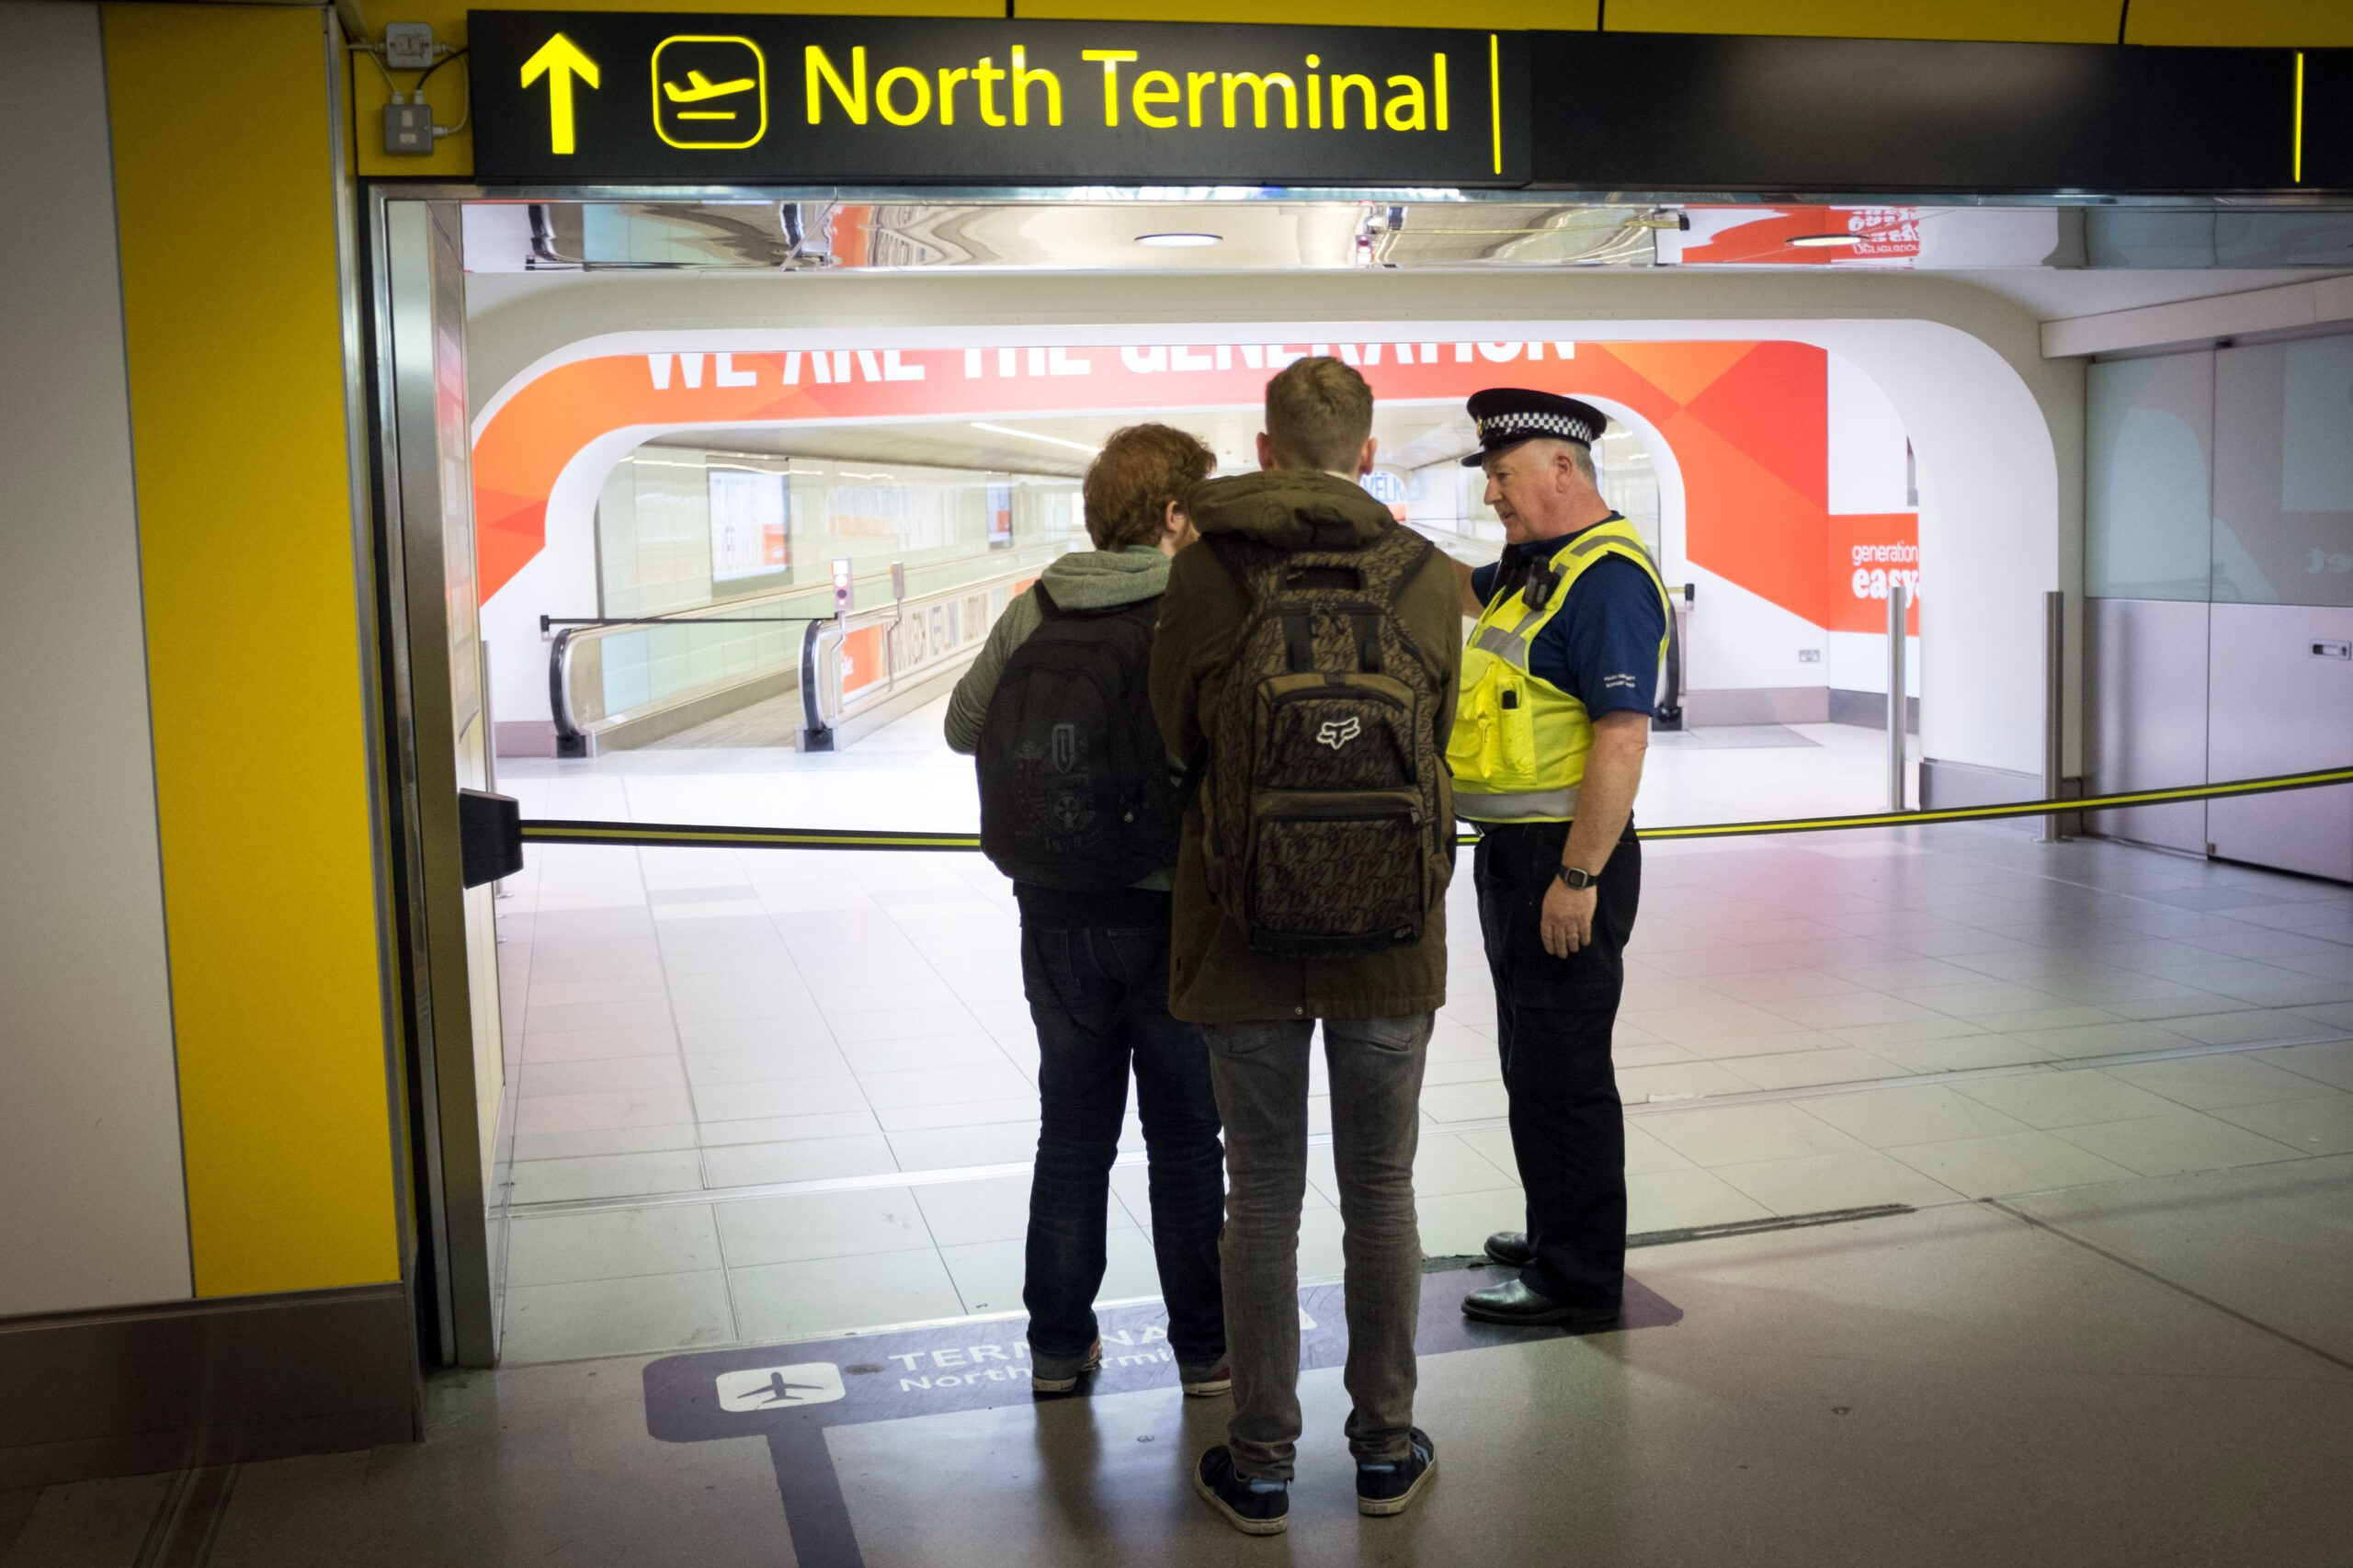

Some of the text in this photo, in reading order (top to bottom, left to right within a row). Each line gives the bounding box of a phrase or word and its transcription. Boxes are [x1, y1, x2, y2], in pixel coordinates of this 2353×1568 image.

[805, 44, 1449, 131] North Terminal
[1851, 540, 1919, 566] generation
[1851, 568, 1920, 609] easy
[900, 1365, 1032, 1392] North
